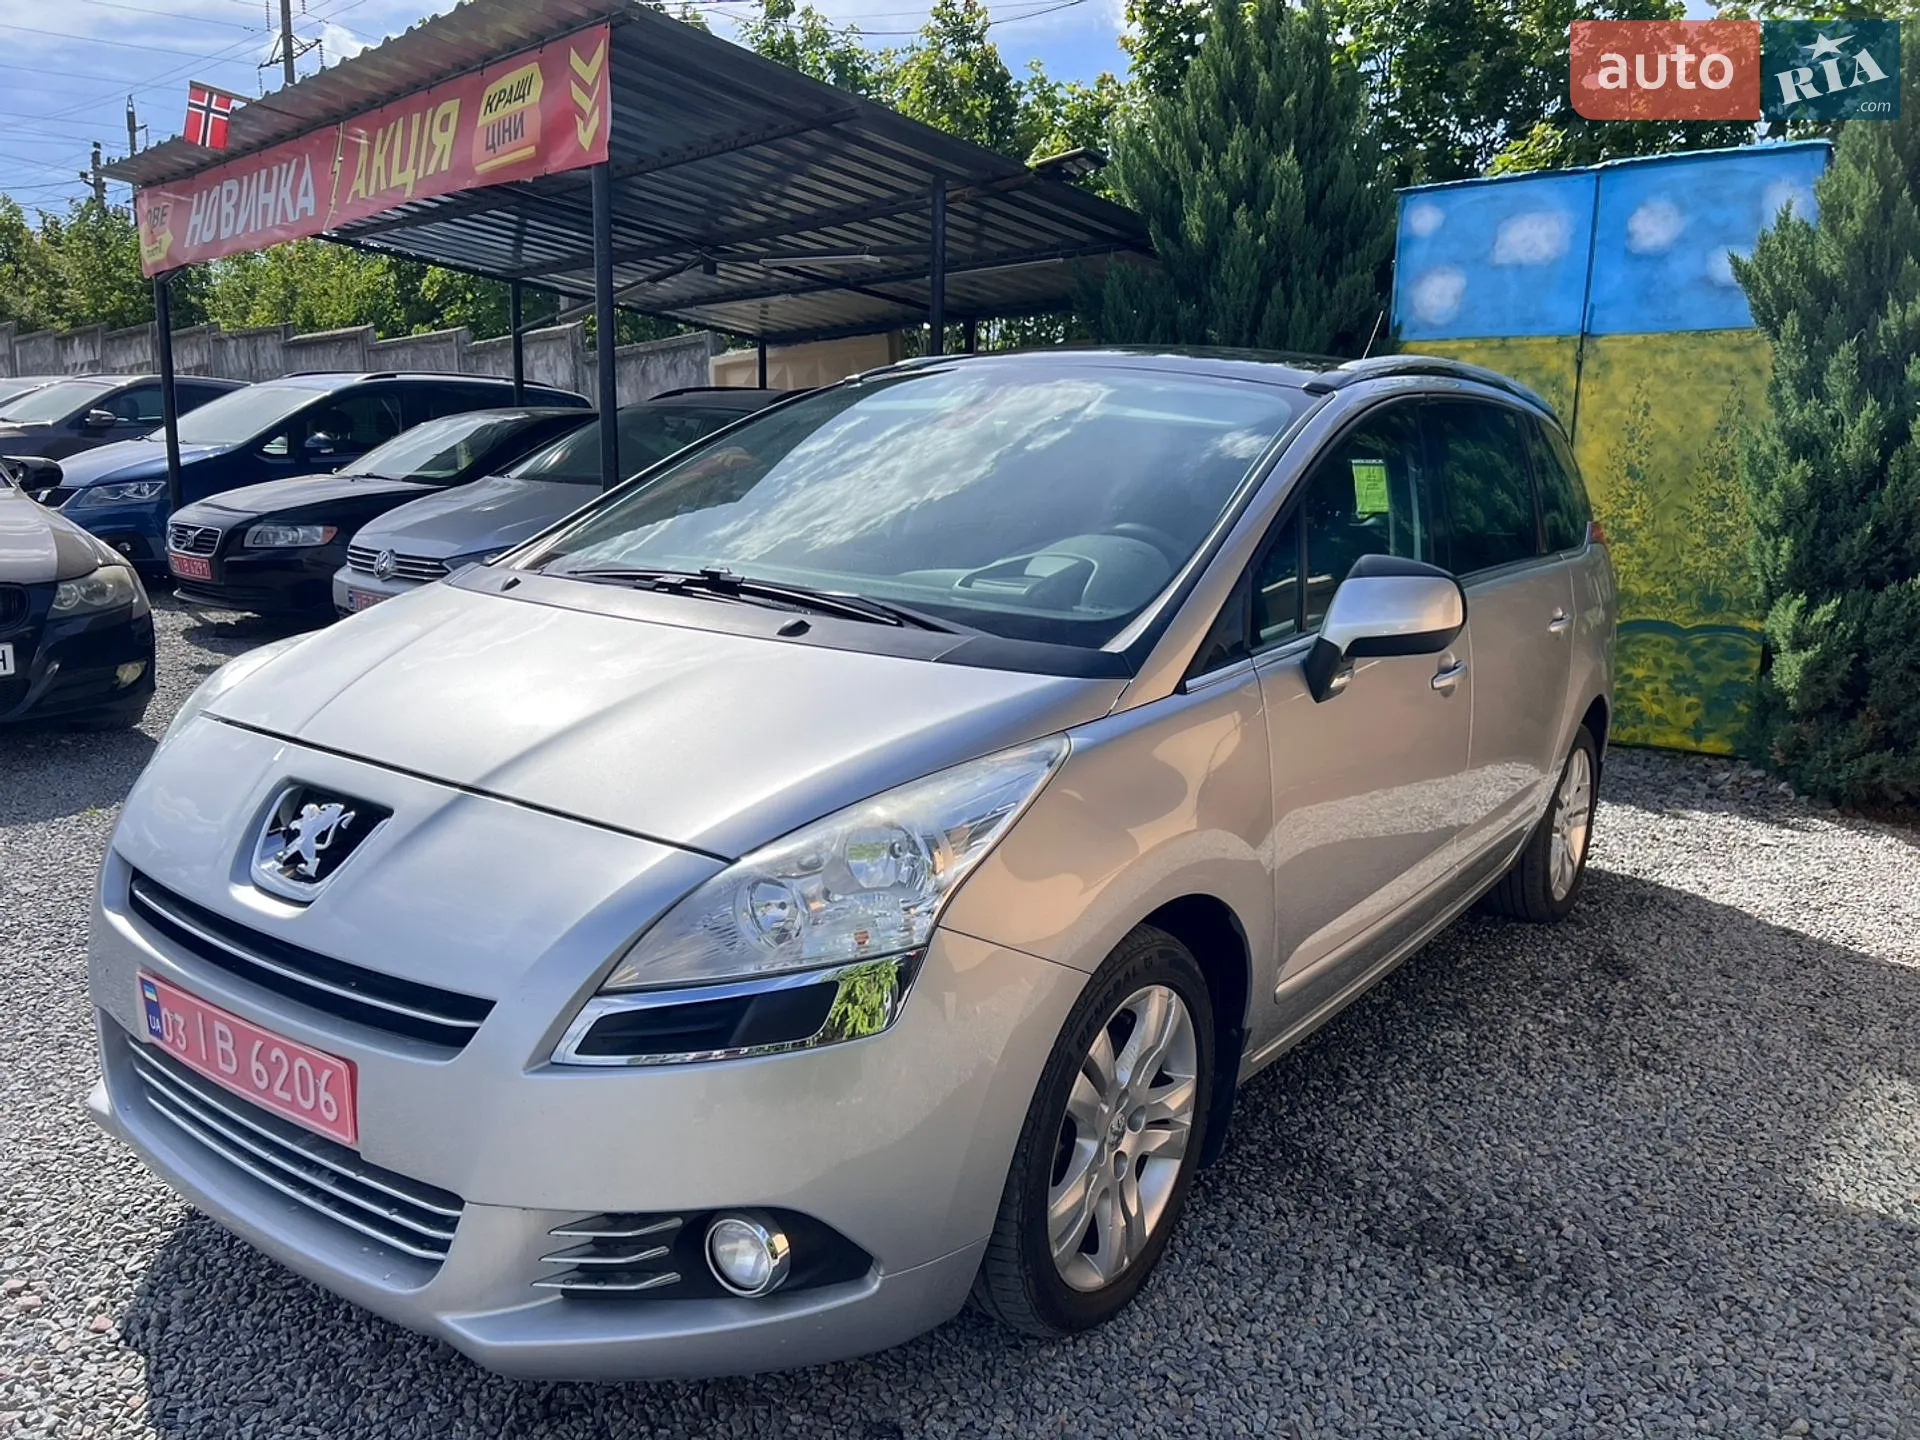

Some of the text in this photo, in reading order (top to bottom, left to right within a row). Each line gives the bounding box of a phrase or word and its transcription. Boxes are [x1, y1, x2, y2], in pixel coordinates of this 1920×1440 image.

[483, 72, 534, 116] КРАЩІ
[485, 110, 525, 154] ЦІНИ
[183, 98, 460, 248] НОВИНКА АКЦІЯ
[149, 1013, 162, 1033] UA
[162, 1007, 187, 1051] 03
[251, 1039, 339, 1122] 6206
